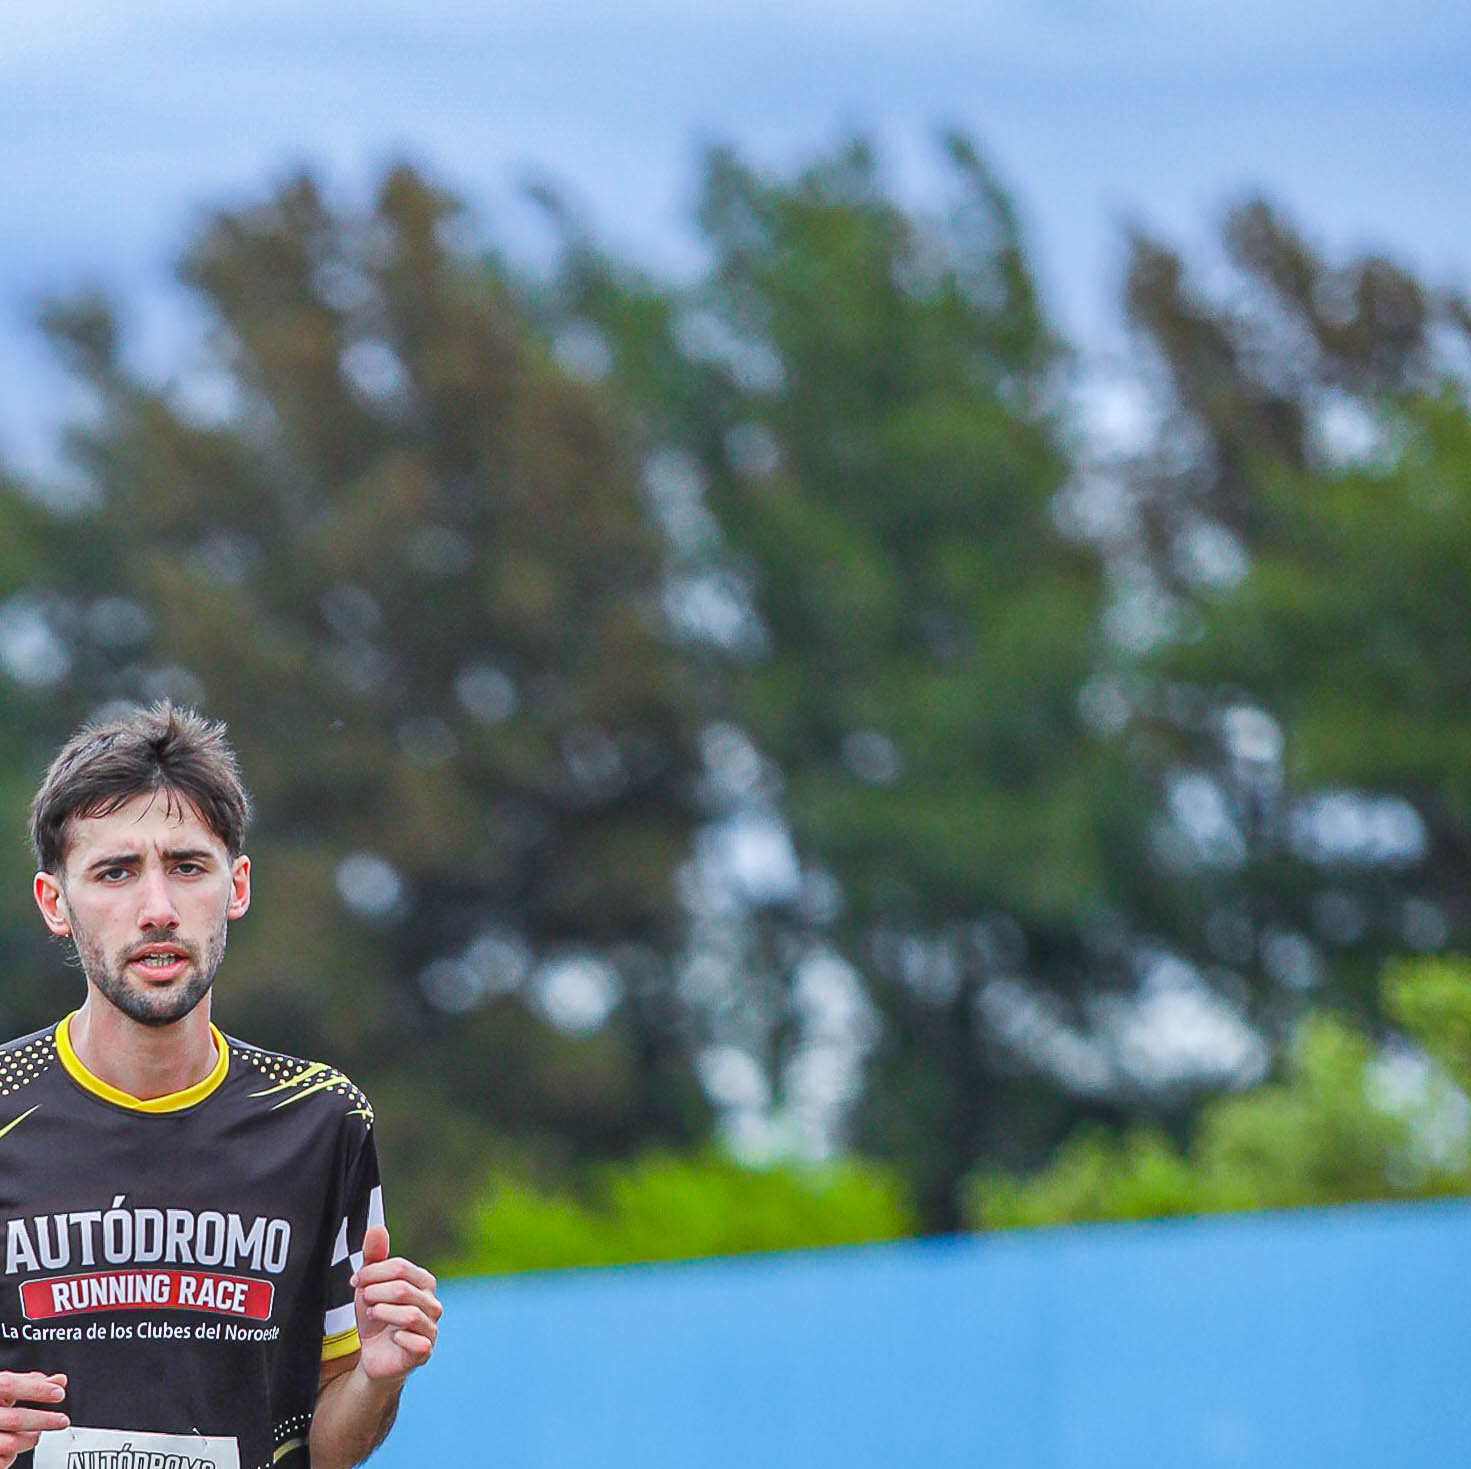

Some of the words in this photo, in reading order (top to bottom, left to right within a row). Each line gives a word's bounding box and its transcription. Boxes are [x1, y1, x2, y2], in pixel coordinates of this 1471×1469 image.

[4, 1195, 292, 1275] AUTÓDROMO
[50, 1274, 171, 1313] RUNNING
[178, 1275, 249, 1313] RACE
[1, 1322, 19, 1340] La
[22, 1324, 82, 1341] Carrera
[86, 1323, 107, 1340] de
[110, 1321, 133, 1340] los
[137, 1321, 191, 1340] Clubes
[195, 1323, 220, 1340] del
[224, 1324, 280, 1342] Noroeste
